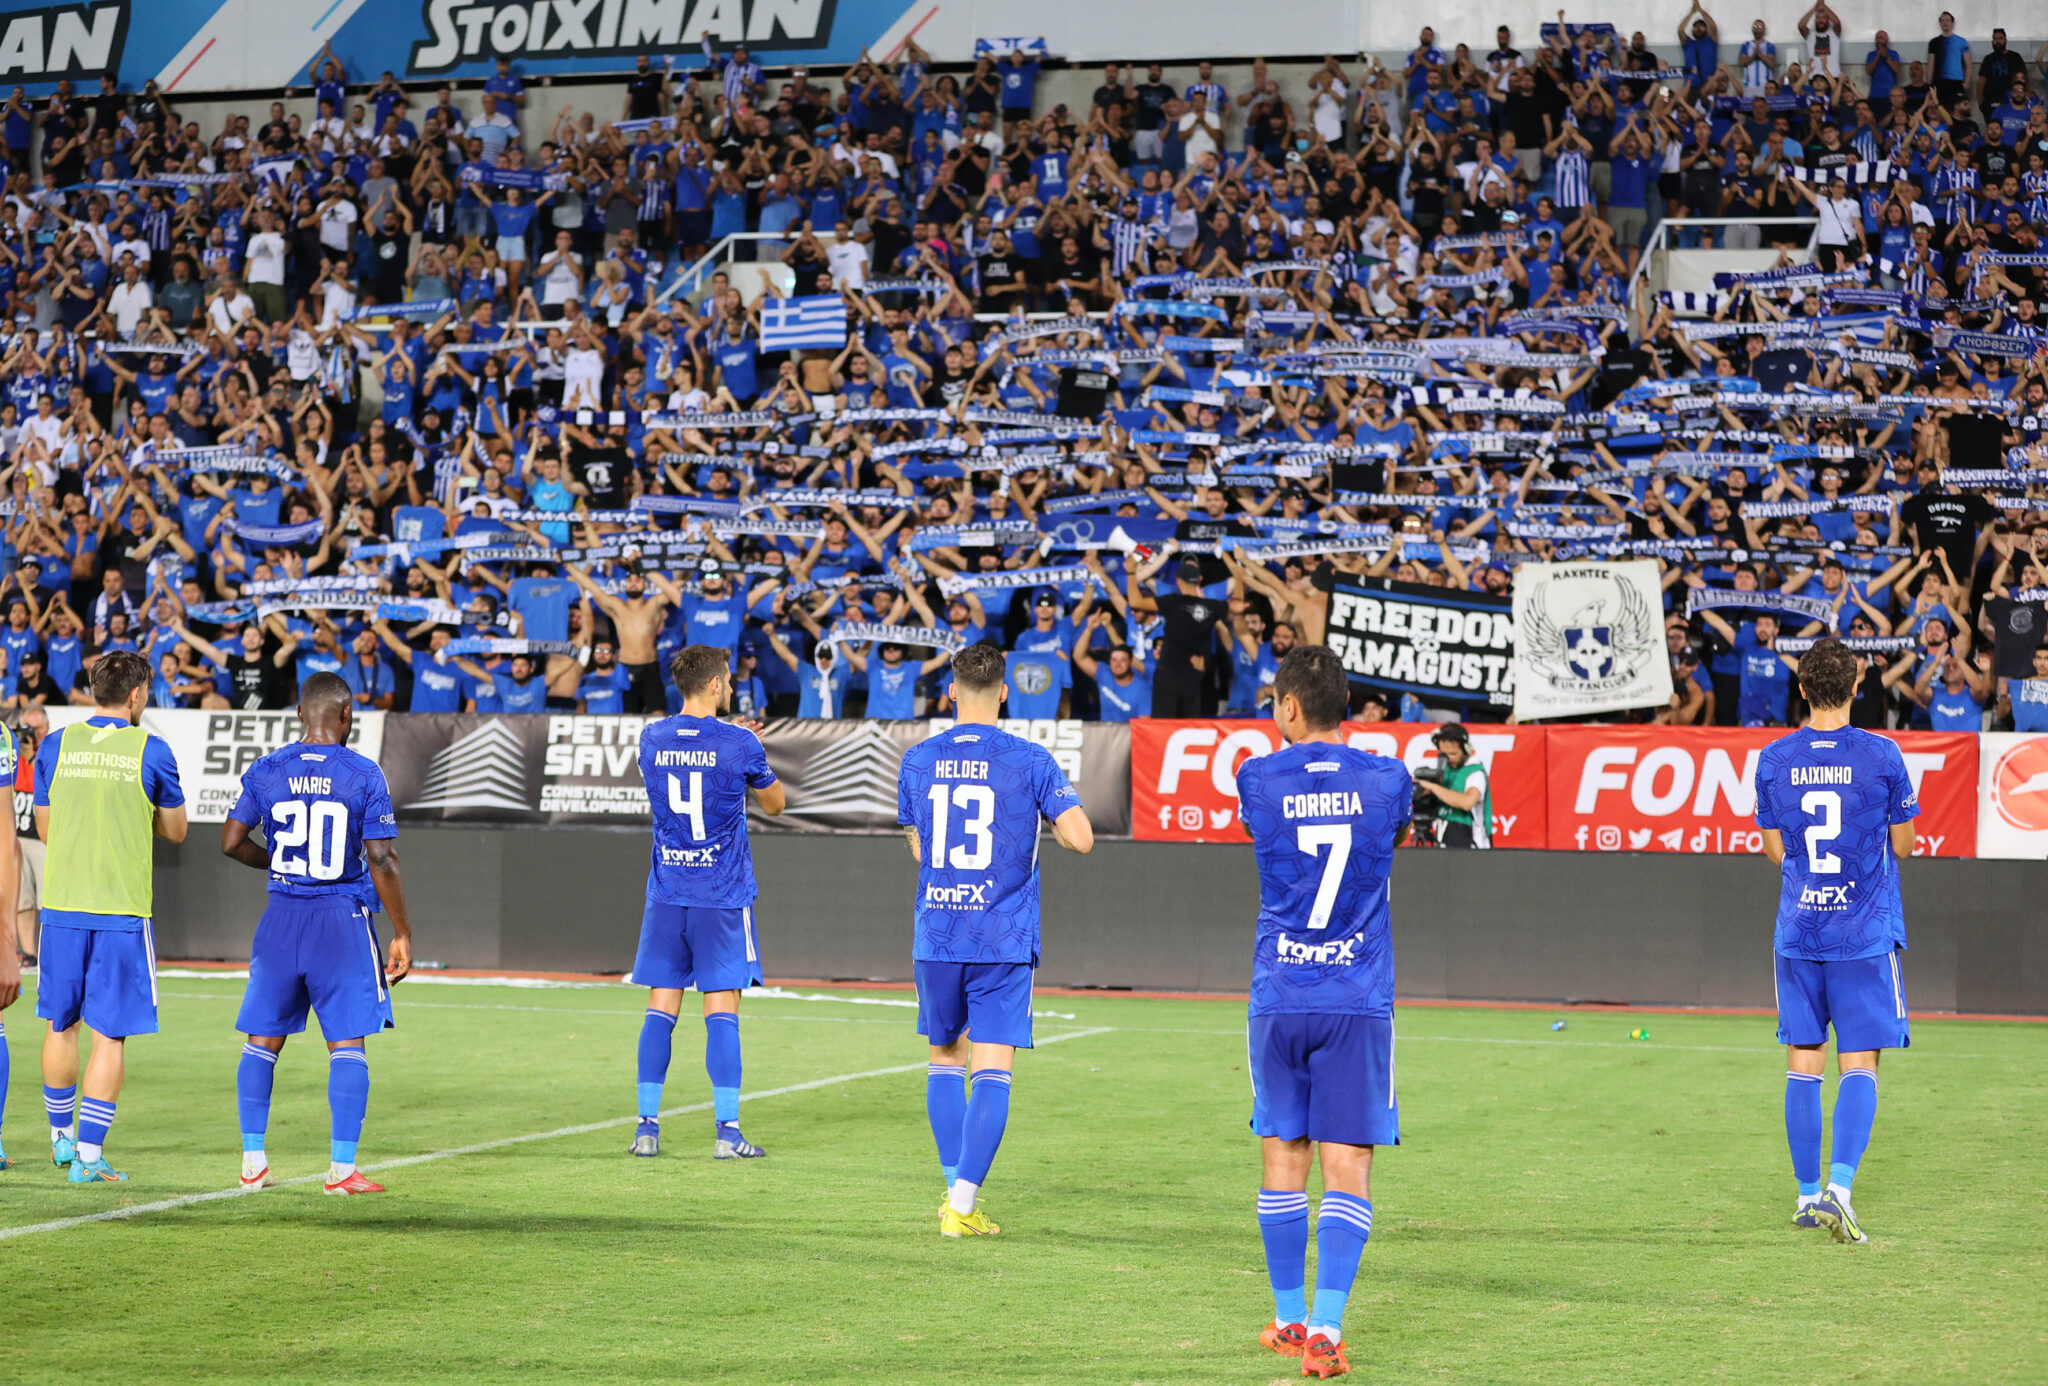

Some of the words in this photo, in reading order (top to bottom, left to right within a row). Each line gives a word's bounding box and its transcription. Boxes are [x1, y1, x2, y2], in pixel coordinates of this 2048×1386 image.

[414, 0, 823, 69] STOIXIMAN
[1927, 502, 1967, 514] DEFEND
[975, 567, 1098, 589] MAXHTE
[60, 751, 139, 771] ANORTHOSIS
[654, 750, 717, 767] ARTYMATAS
[59, 768, 108, 780] FAMAGUSTA
[109, 771, 121, 782] FC
[935, 760, 989, 780] HELDER
[1791, 766, 1852, 786] BAIXINHO
[288, 776, 332, 795] WARIS
[541, 785, 650, 801] CONSTRUCTIO
[667, 771, 706, 841] 4
[1282, 791, 1364, 820] CORREIA
[927, 783, 996, 871] 13
[1800, 790, 1843, 874] 2
[270, 799, 349, 881] 20
[1297, 823, 1353, 930] 7
[925, 881, 987, 904] IronFX
[925, 902, 945, 910] SOLID
[1813, 904, 1848, 912] TRADING
[1276, 932, 1356, 963] IronFX
[1277, 955, 1305, 965] SOLID
